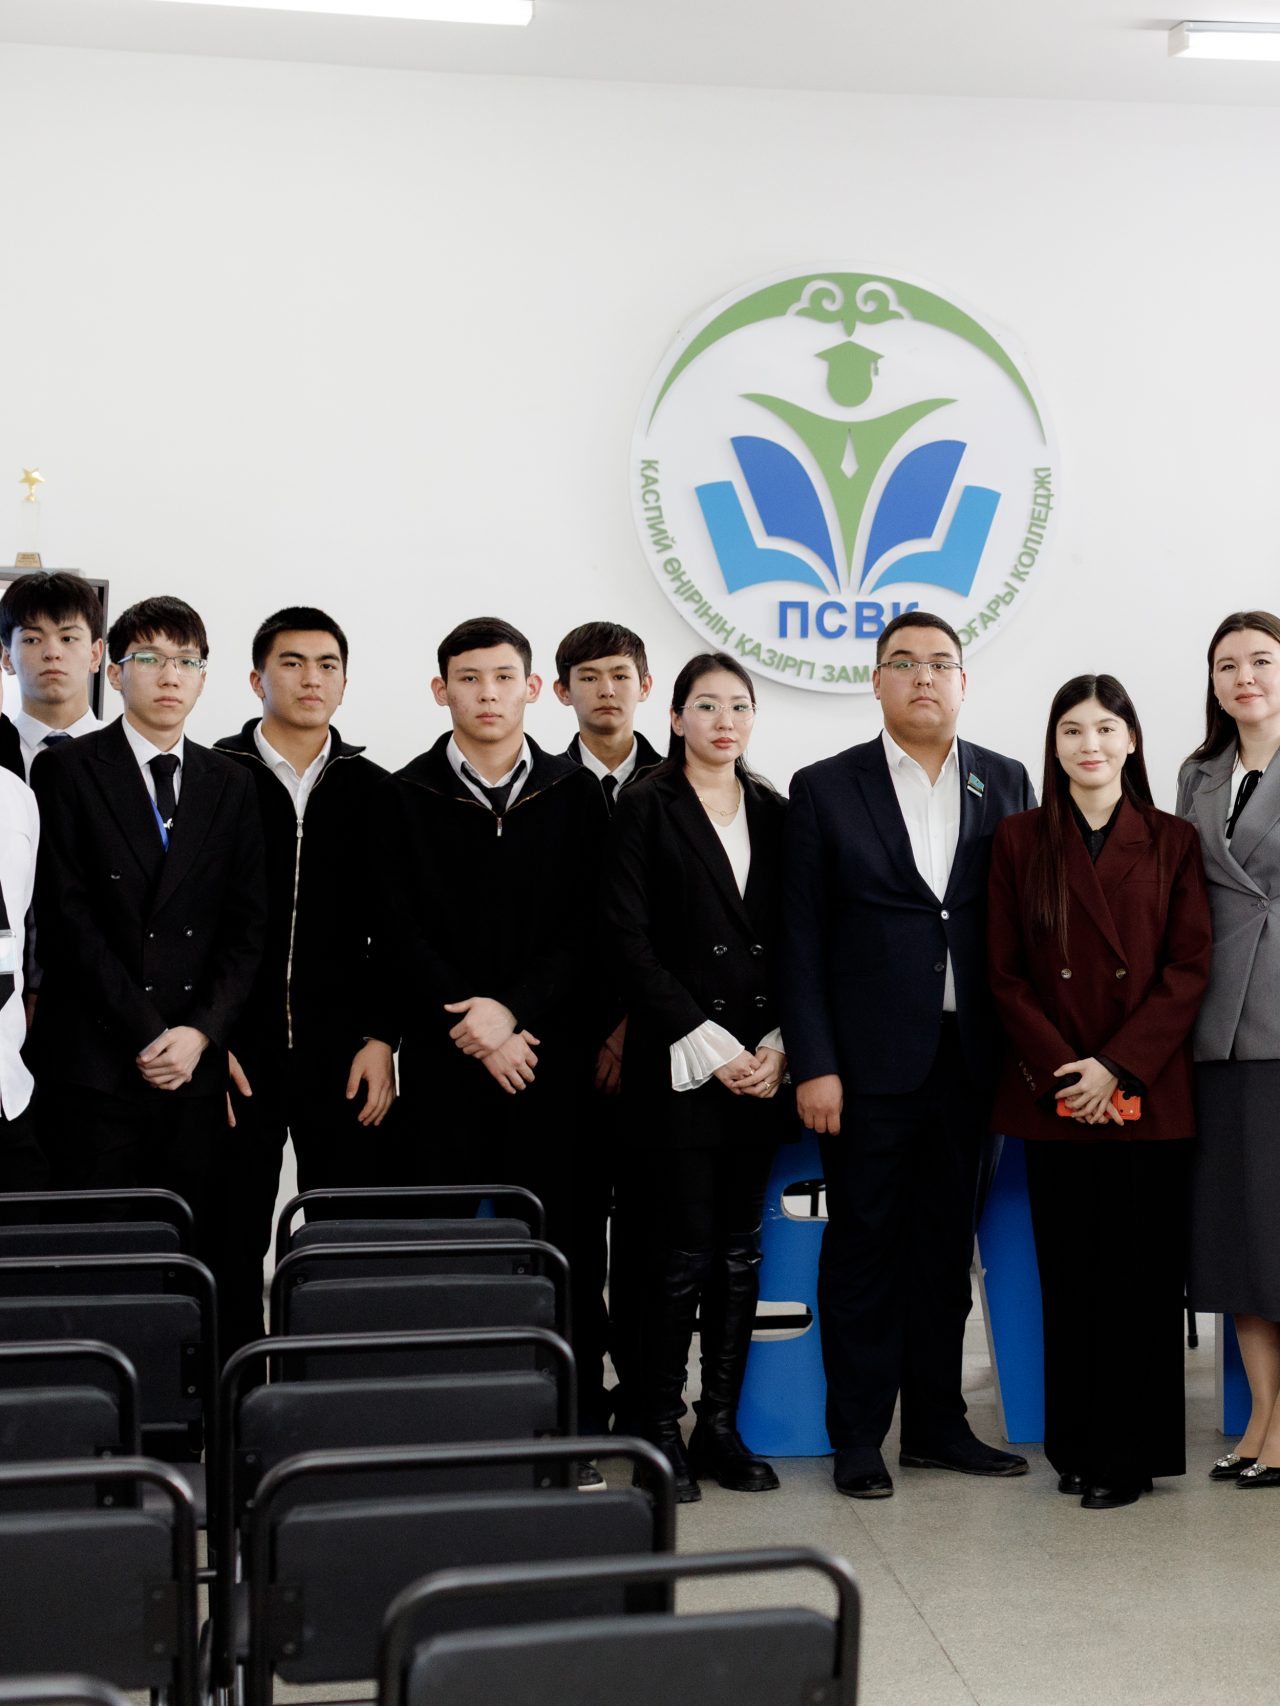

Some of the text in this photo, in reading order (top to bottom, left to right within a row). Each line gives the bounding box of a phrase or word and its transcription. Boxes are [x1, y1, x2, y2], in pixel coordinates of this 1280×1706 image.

[640, 459, 676, 554] КАСПИЙ
[663, 557, 736, 645] ӨҢІРІНІҢ
[734, 633, 816, 680] ҚАЗІРГІ
[955, 581, 1020, 647] ОҒАРЫ
[1010, 466, 1054, 583] КОЛЛЕДЖІ
